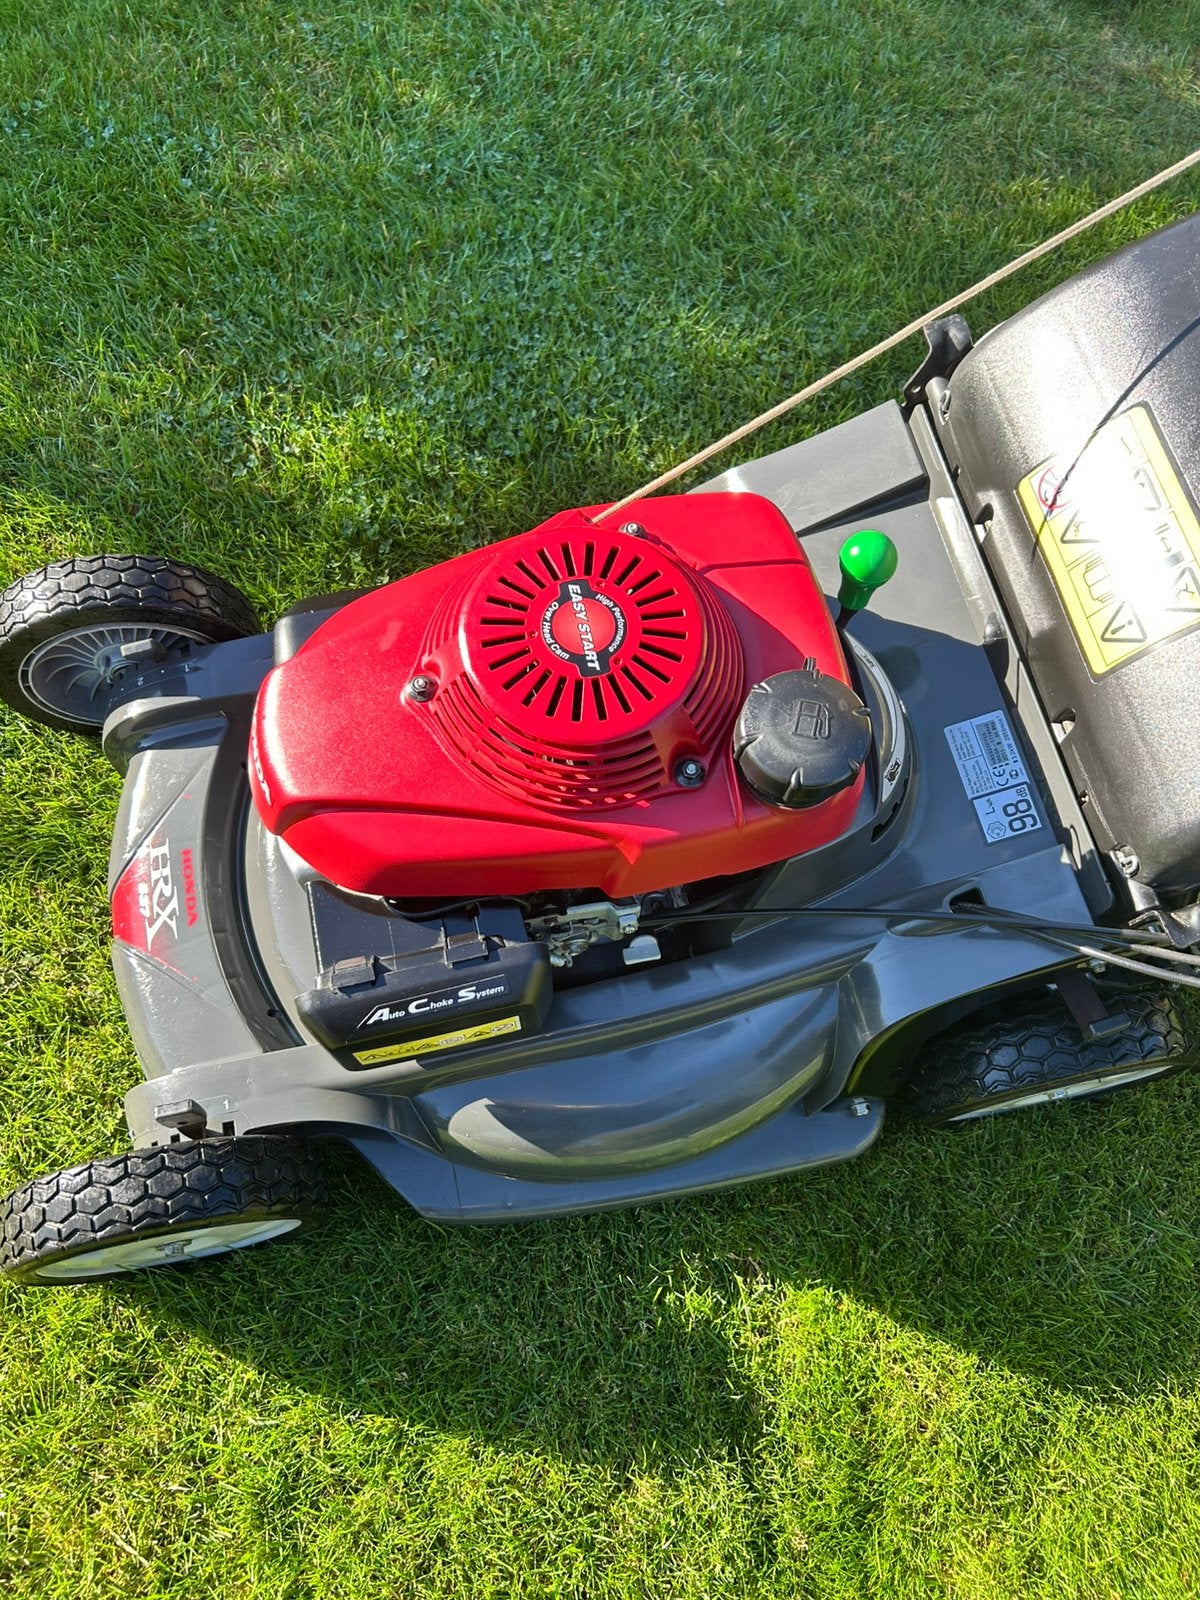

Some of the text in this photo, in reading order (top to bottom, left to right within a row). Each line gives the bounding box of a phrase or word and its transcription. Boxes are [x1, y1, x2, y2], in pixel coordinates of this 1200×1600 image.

[542, 601, 570, 660] Over Head Cam
[568, 584, 601, 671] EASY START
[595, 594, 624, 652] High Performance
[1002, 786, 1038, 832] 98 dB
[145, 837, 179, 952] HRX
[180, 847, 199, 928] HONDA
[366, 985, 505, 1025] Auto Choke System
[223, 1099, 229, 1111] 1
